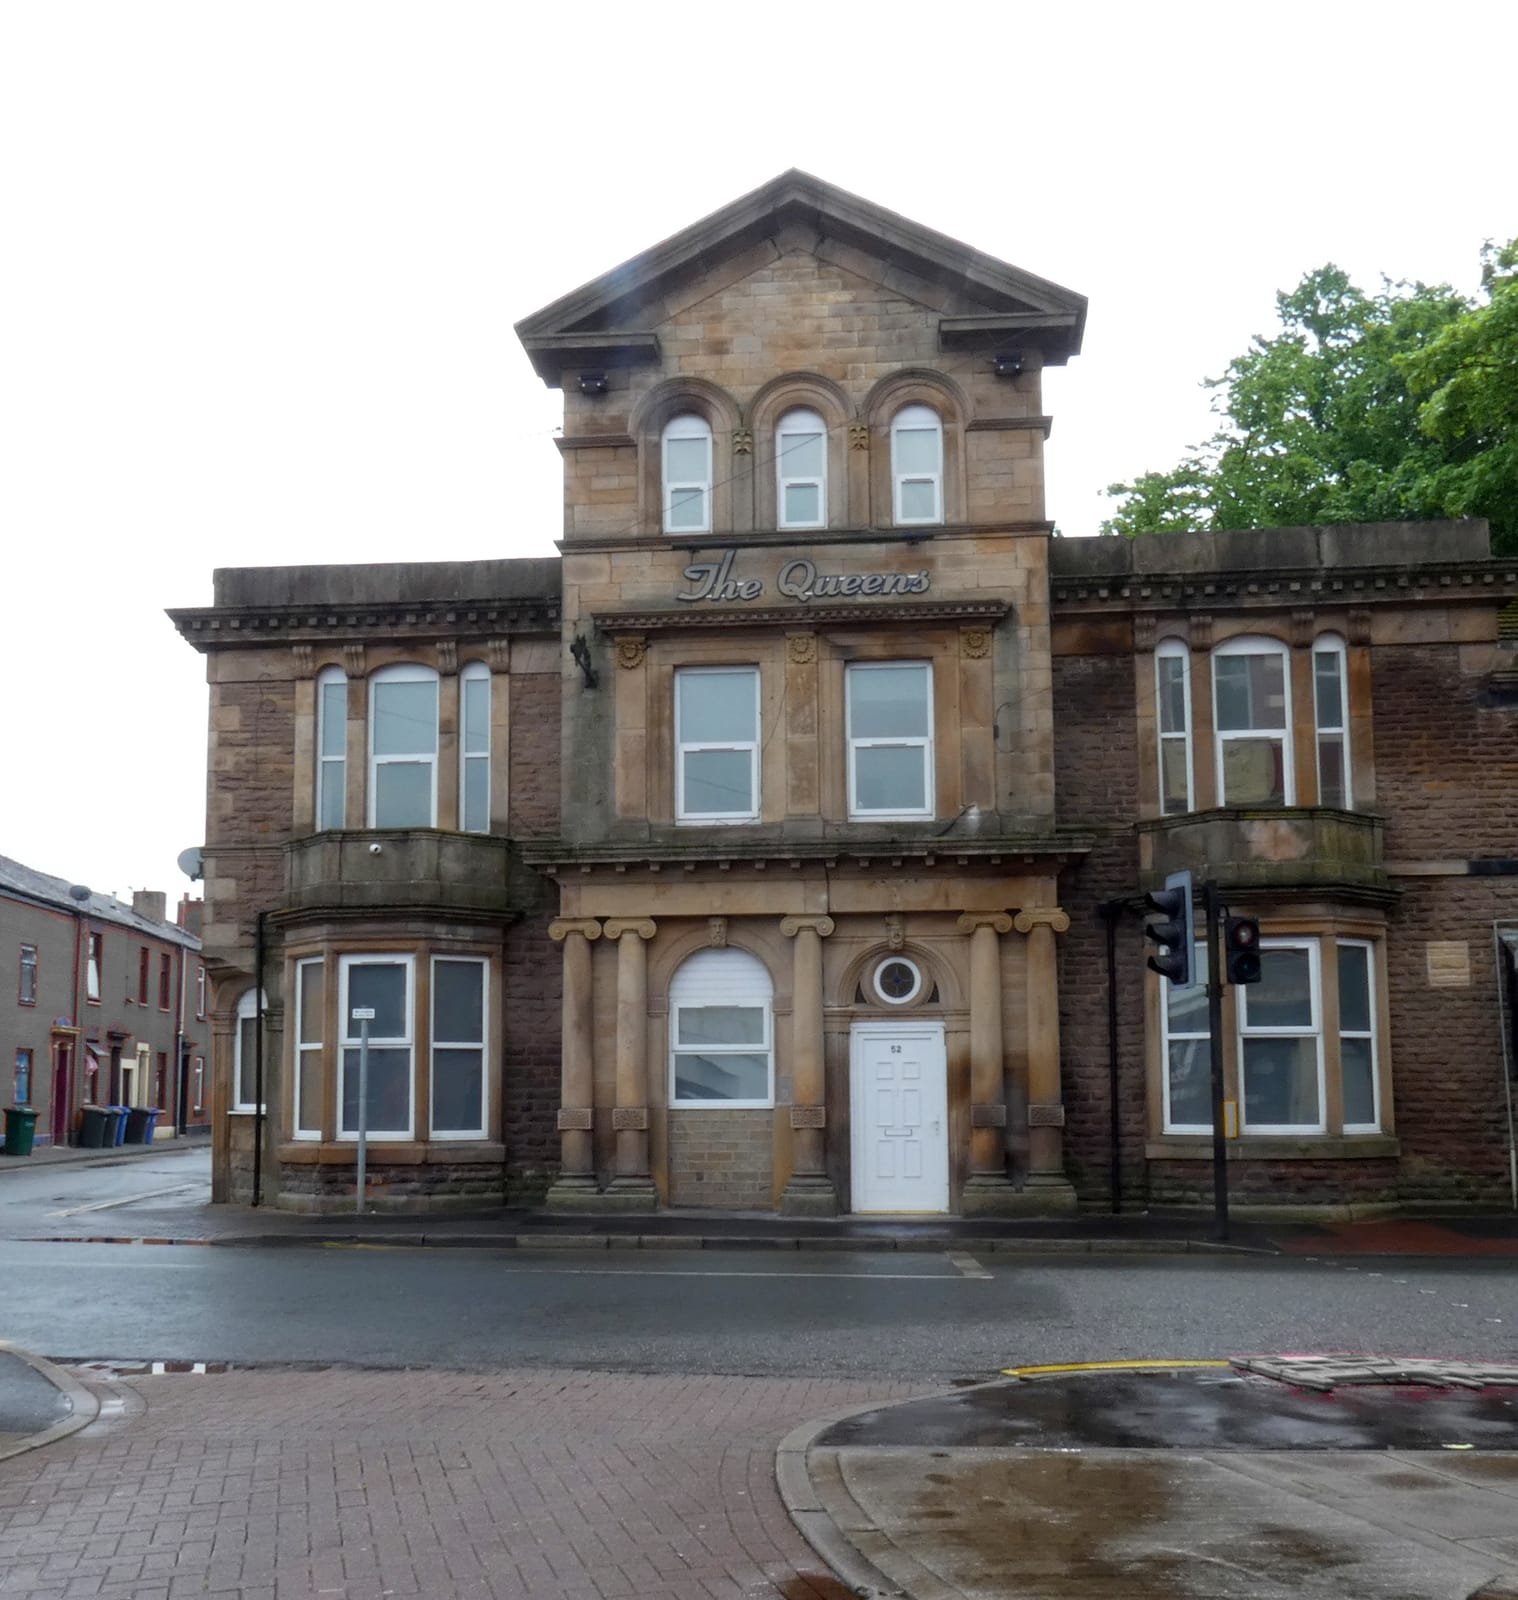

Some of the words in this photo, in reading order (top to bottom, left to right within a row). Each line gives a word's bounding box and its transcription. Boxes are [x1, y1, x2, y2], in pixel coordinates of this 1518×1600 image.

[676, 549, 763, 602] The
[778, 559, 930, 602] Queens
[891, 1045, 902, 1053] 52
